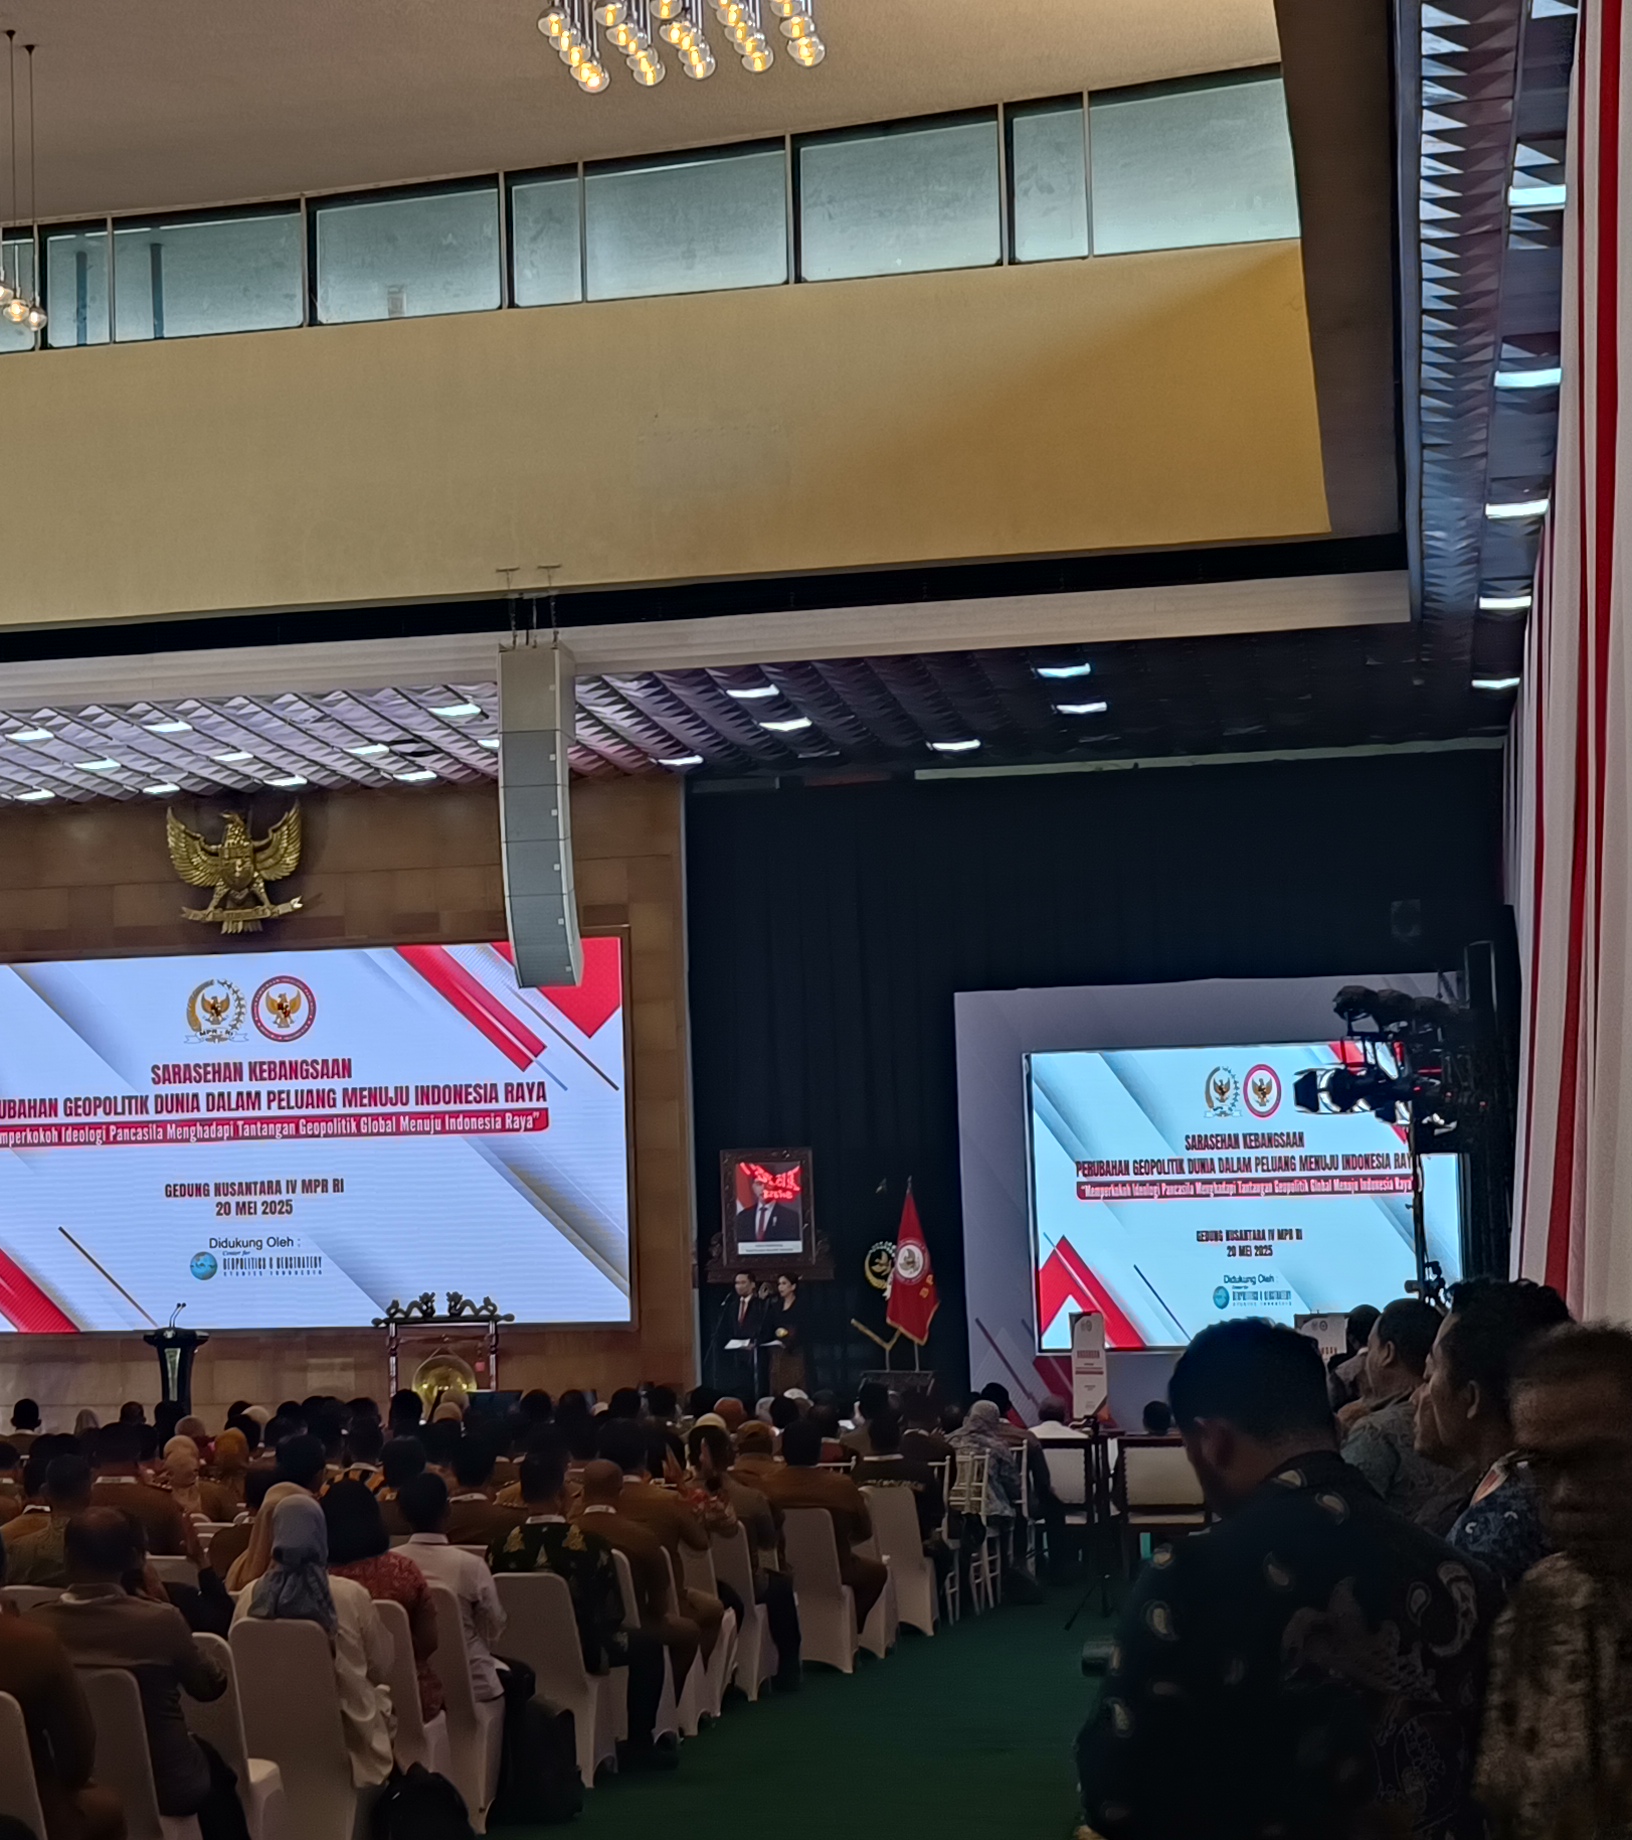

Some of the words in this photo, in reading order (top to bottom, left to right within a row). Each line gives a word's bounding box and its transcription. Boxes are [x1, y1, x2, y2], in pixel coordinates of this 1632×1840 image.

[151, 1061, 243, 1085] SARASEHAN
[248, 1058, 352, 1082] KEBANGSAAN
[63, 1095, 150, 1117] GEOPOLITIK
[154, 1092, 201, 1115] DUNIA
[206, 1090, 262, 1112] DALAM
[267, 1087, 337, 1110] PELUANG
[342, 1085, 410, 1108] MENUJU
[414, 1082, 499, 1106] INDONESIA
[504, 1081, 547, 1103] RAYA
[62, 1126, 106, 1146] Ideologi
[109, 1123, 164, 1143] Pancasila
[166, 1122, 235, 1143] Menghadapi
[237, 1120, 296, 1139] Tantangan
[299, 1117, 358, 1137] Geopolitik
[360, 1115, 396, 1133] Global
[399, 1113, 442, 1135] Menuju
[445, 1112, 502, 1131] Indonesia
[1185, 1133, 1240, 1150] SARASEHAN
[1243, 1131, 1304, 1149] KEBANGSAAN
[1076, 1160, 1130, 1177] PERUBAHAN
[1133, 1158, 1185, 1175] GEOPOLITIK
[1188, 1157, 1216, 1174] DUNIA
[1219, 1156, 1252, 1173] DALAM
[1255, 1154, 1296, 1172] PELUANG
[1299, 1153, 1339, 1171] MENUJU
[1342, 1152, 1391, 1170] INDONESIA
[165, 1183, 210, 1198] GEDUNG
[214, 1180, 282, 1197] NUSANTARA
[286, 1180, 297, 1194] IV
[301, 1179, 328, 1194] MPR
[333, 1178, 344, 1193] RI
[215, 1201, 231, 1216] 20
[235, 1201, 257, 1215] MEI
[261, 1199, 293, 1215] 2025
[209, 1237, 263, 1250] Didukung
[267, 1236, 294, 1247] Oleh
[1227, 1245, 1236, 1257] 20
[1239, 1245, 1252, 1257] MEI
[1254, 1244, 1273, 1257] 2025
